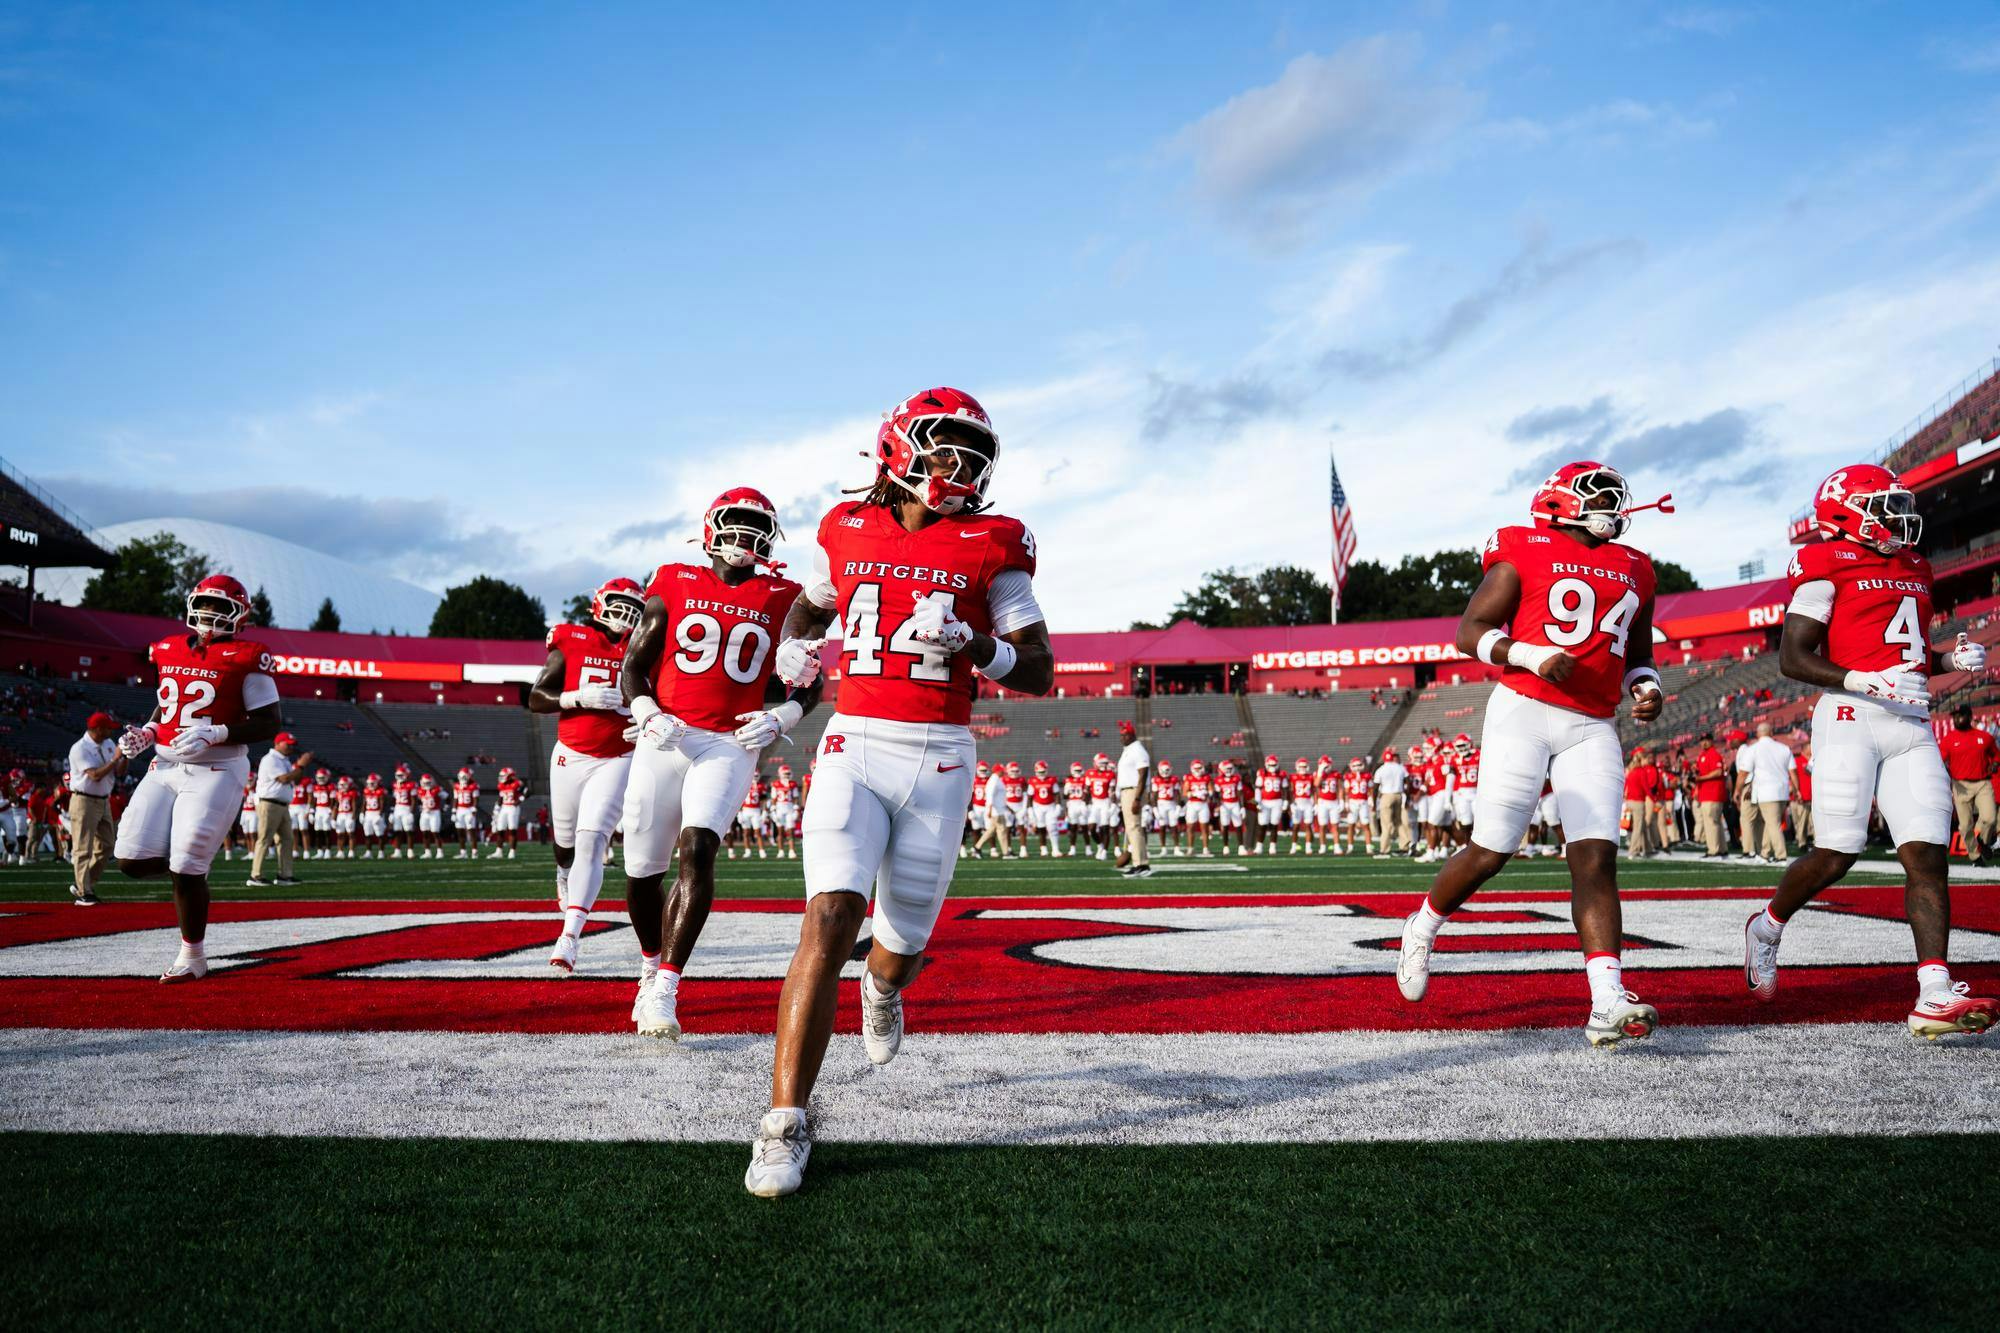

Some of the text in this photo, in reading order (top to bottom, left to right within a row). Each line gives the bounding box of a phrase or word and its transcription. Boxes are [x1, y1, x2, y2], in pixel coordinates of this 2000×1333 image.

[1820, 472, 1848, 504] R
[844, 561, 969, 590] RUTGERS
[1552, 562, 1637, 589] RUTGERS
[1856, 579, 1929, 595] RUTGERS
[685, 599, 771, 625] RUTGERS
[1543, 577, 1641, 661] 94
[842, 581, 956, 683] 44
[1883, 594, 1928, 665] 4
[674, 612, 772, 685] 90
[1359, 643, 1473, 666] FOOTBA
[161, 665, 218, 679] RUTGERS
[584, 656, 622, 669] RUTG
[1056, 662, 1108, 672] FOOTBALL
[156, 677, 217, 728] 92
[1836, 705, 1856, 721] R
[824, 735, 846, 755] R
[557, 755, 566, 767] R
[1459, 767, 1478, 784] 16
